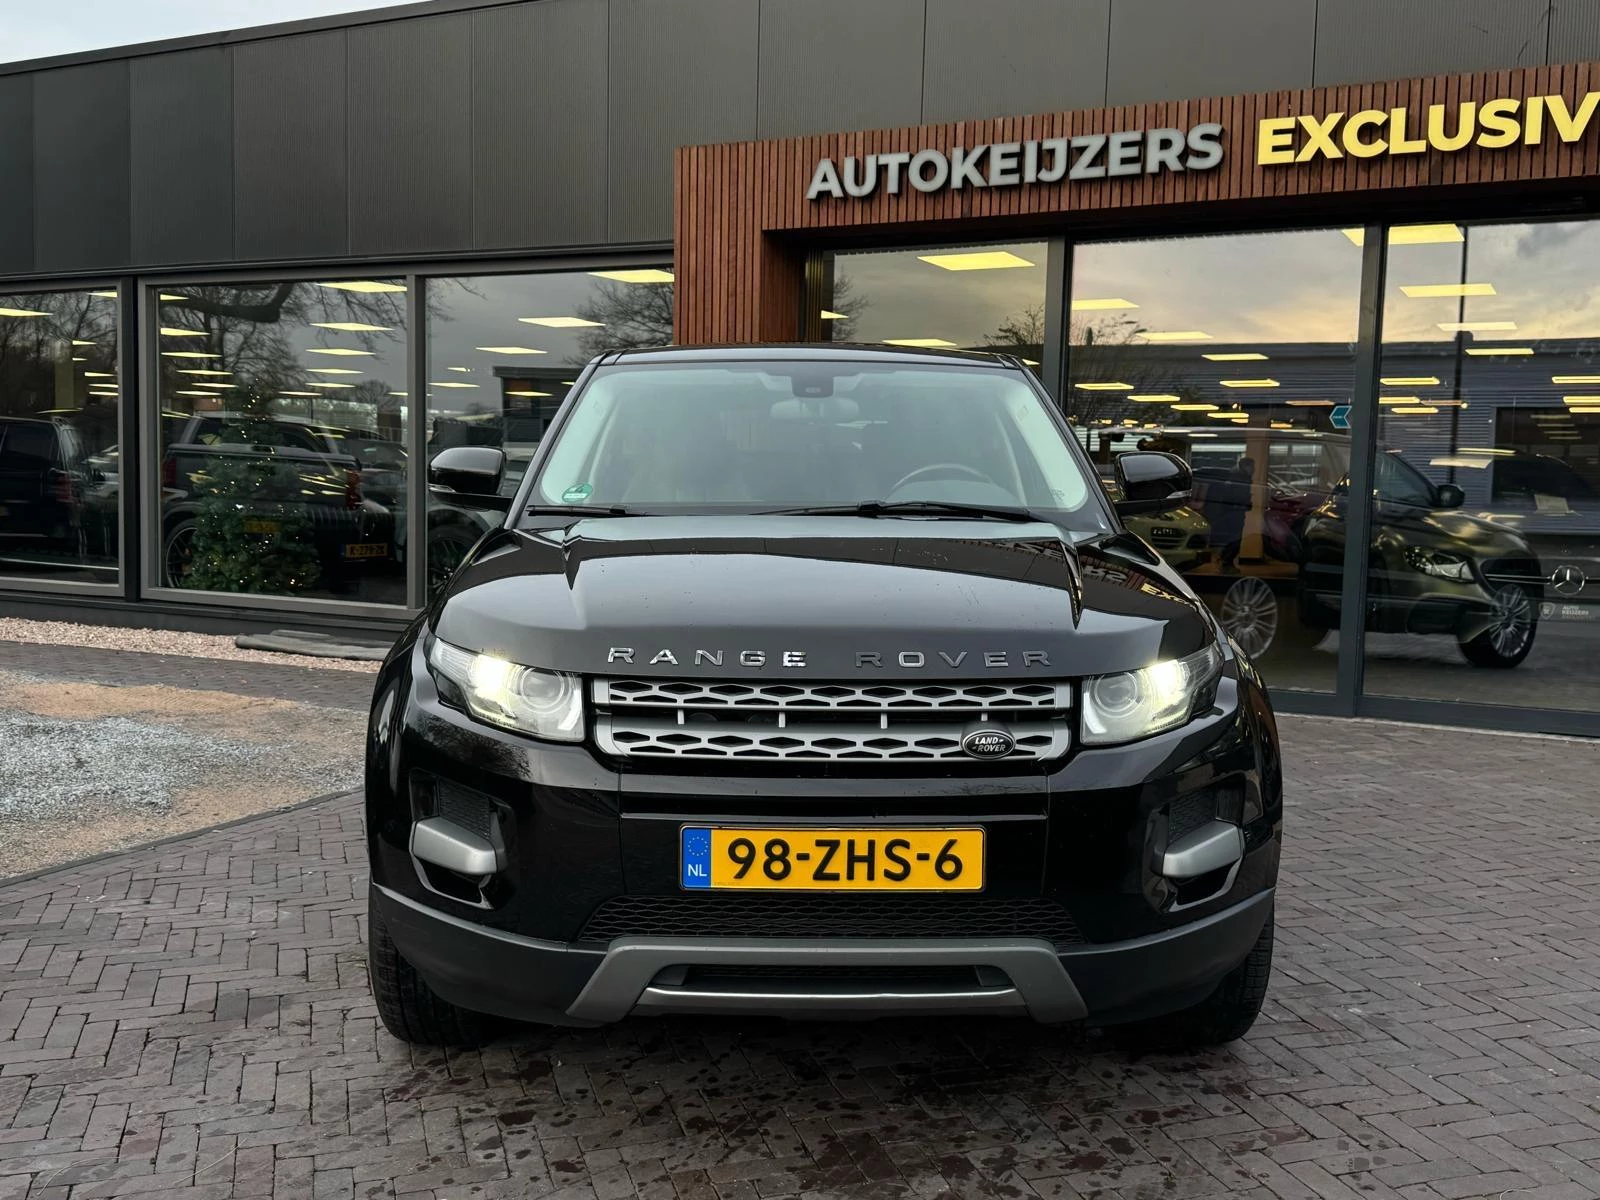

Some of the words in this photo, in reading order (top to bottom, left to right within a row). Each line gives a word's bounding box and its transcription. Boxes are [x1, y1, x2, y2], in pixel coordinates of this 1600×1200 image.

[806, 123, 1224, 200] AUTOKEIJZERS
[1257, 91, 1600, 166] EXCLUSIV
[607, 647, 807, 668] RANGE
[855, 651, 1052, 669] ROVER
[975, 736, 999, 745] LAND
[977, 744, 1006, 752] ROVER
[727, 837, 964, 882] 98-ZHS-6
[687, 863, 708, 877] NL
